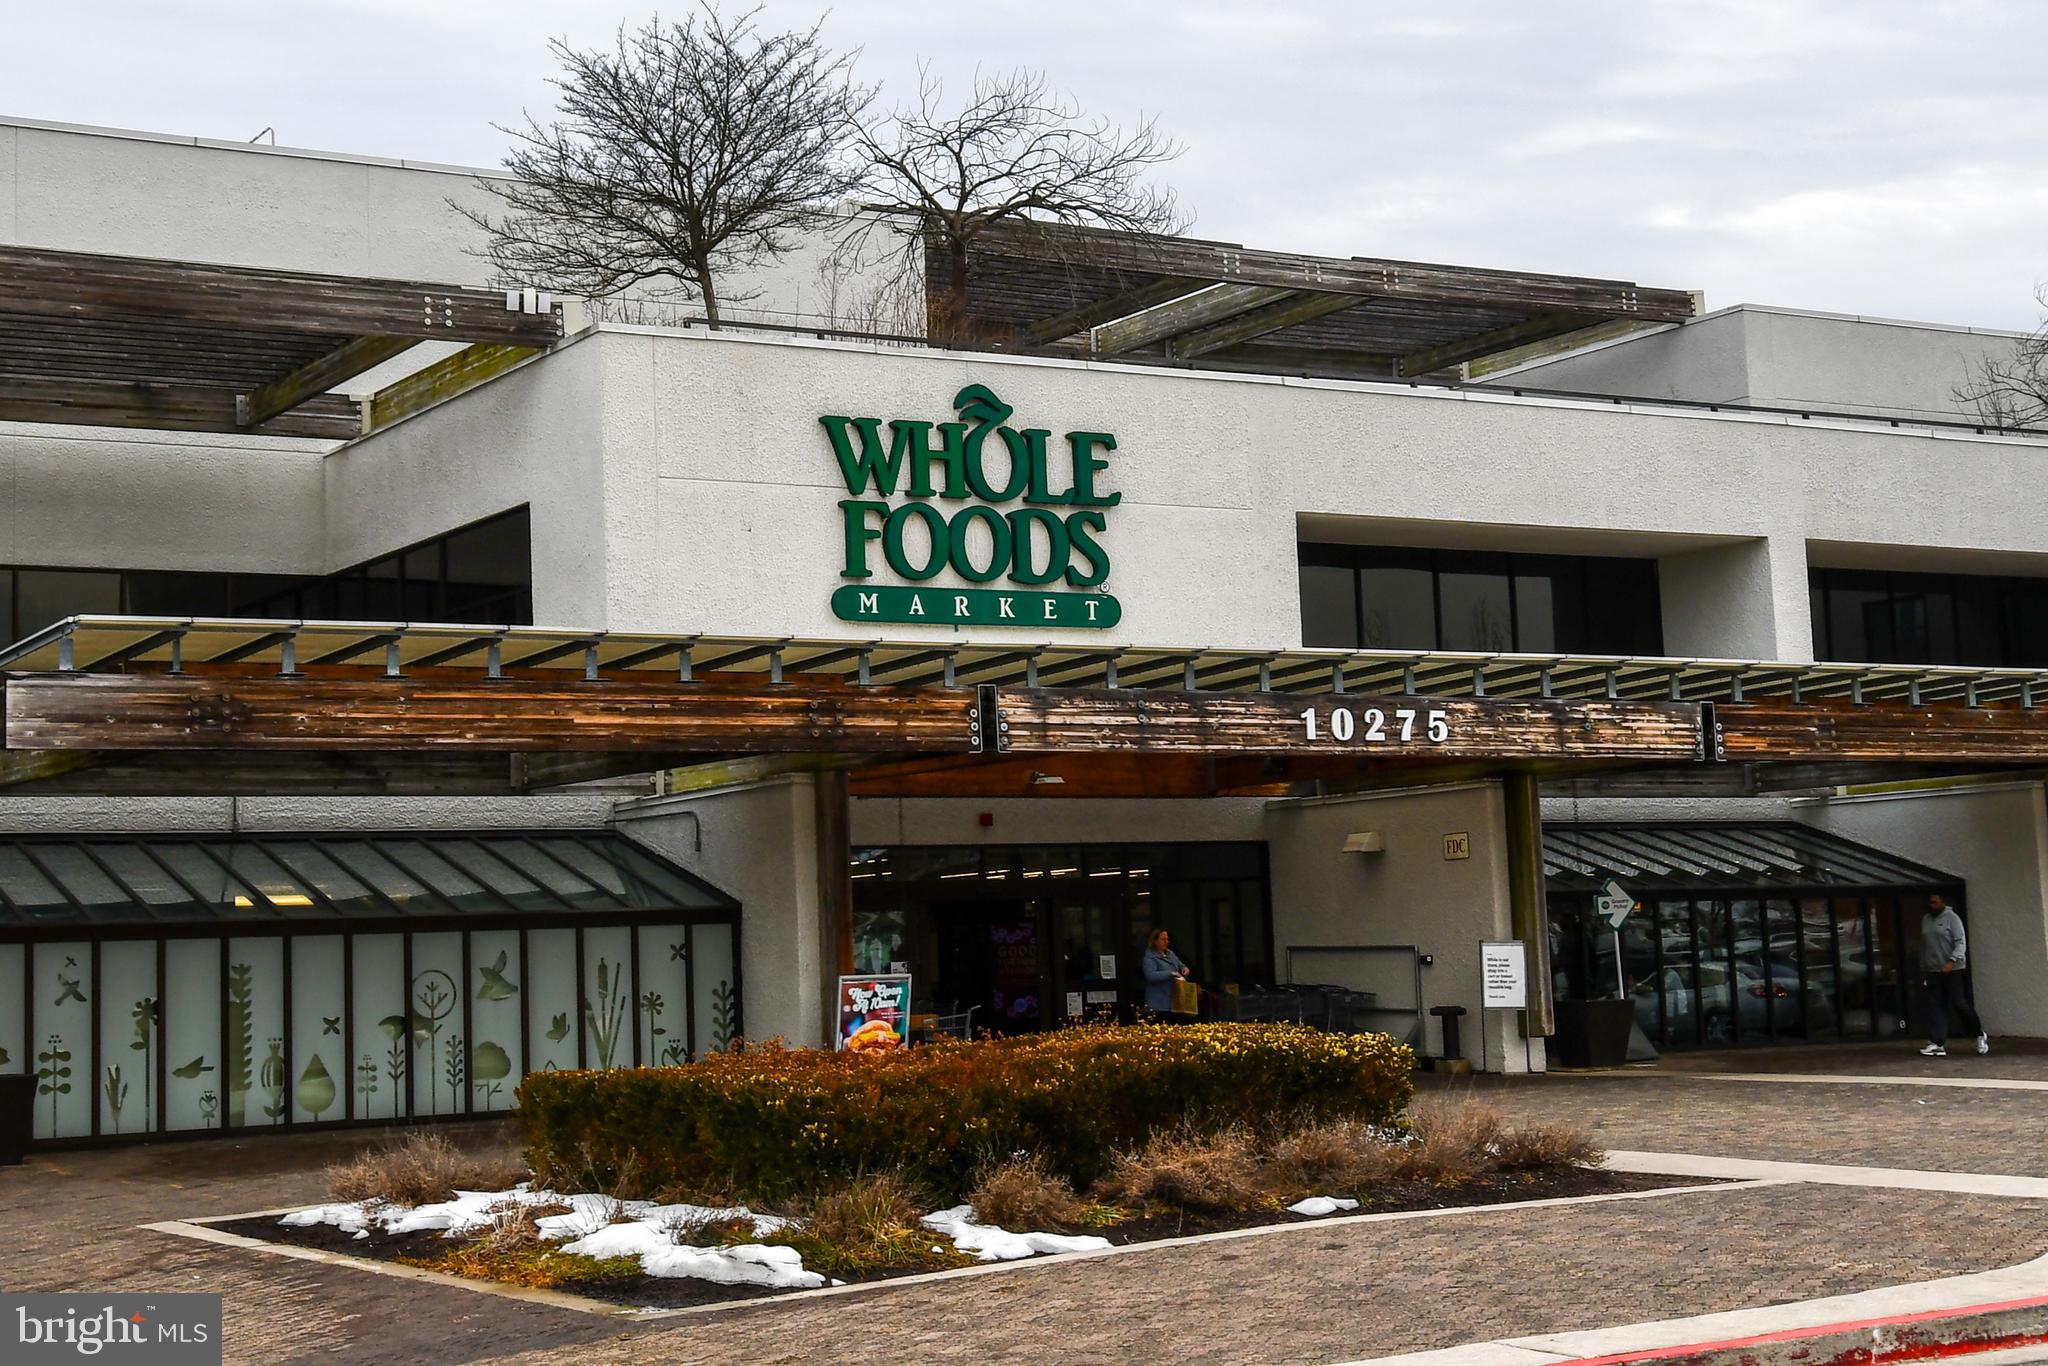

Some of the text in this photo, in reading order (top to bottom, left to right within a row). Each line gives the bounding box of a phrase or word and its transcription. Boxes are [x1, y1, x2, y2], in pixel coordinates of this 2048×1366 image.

[818, 408, 1122, 507] WHOLE
[838, 500, 1110, 587] FOODS
[858, 592, 1099, 621] MARKET
[1300, 707, 1449, 742] 10275
[1446, 838, 1466, 854] FDC
